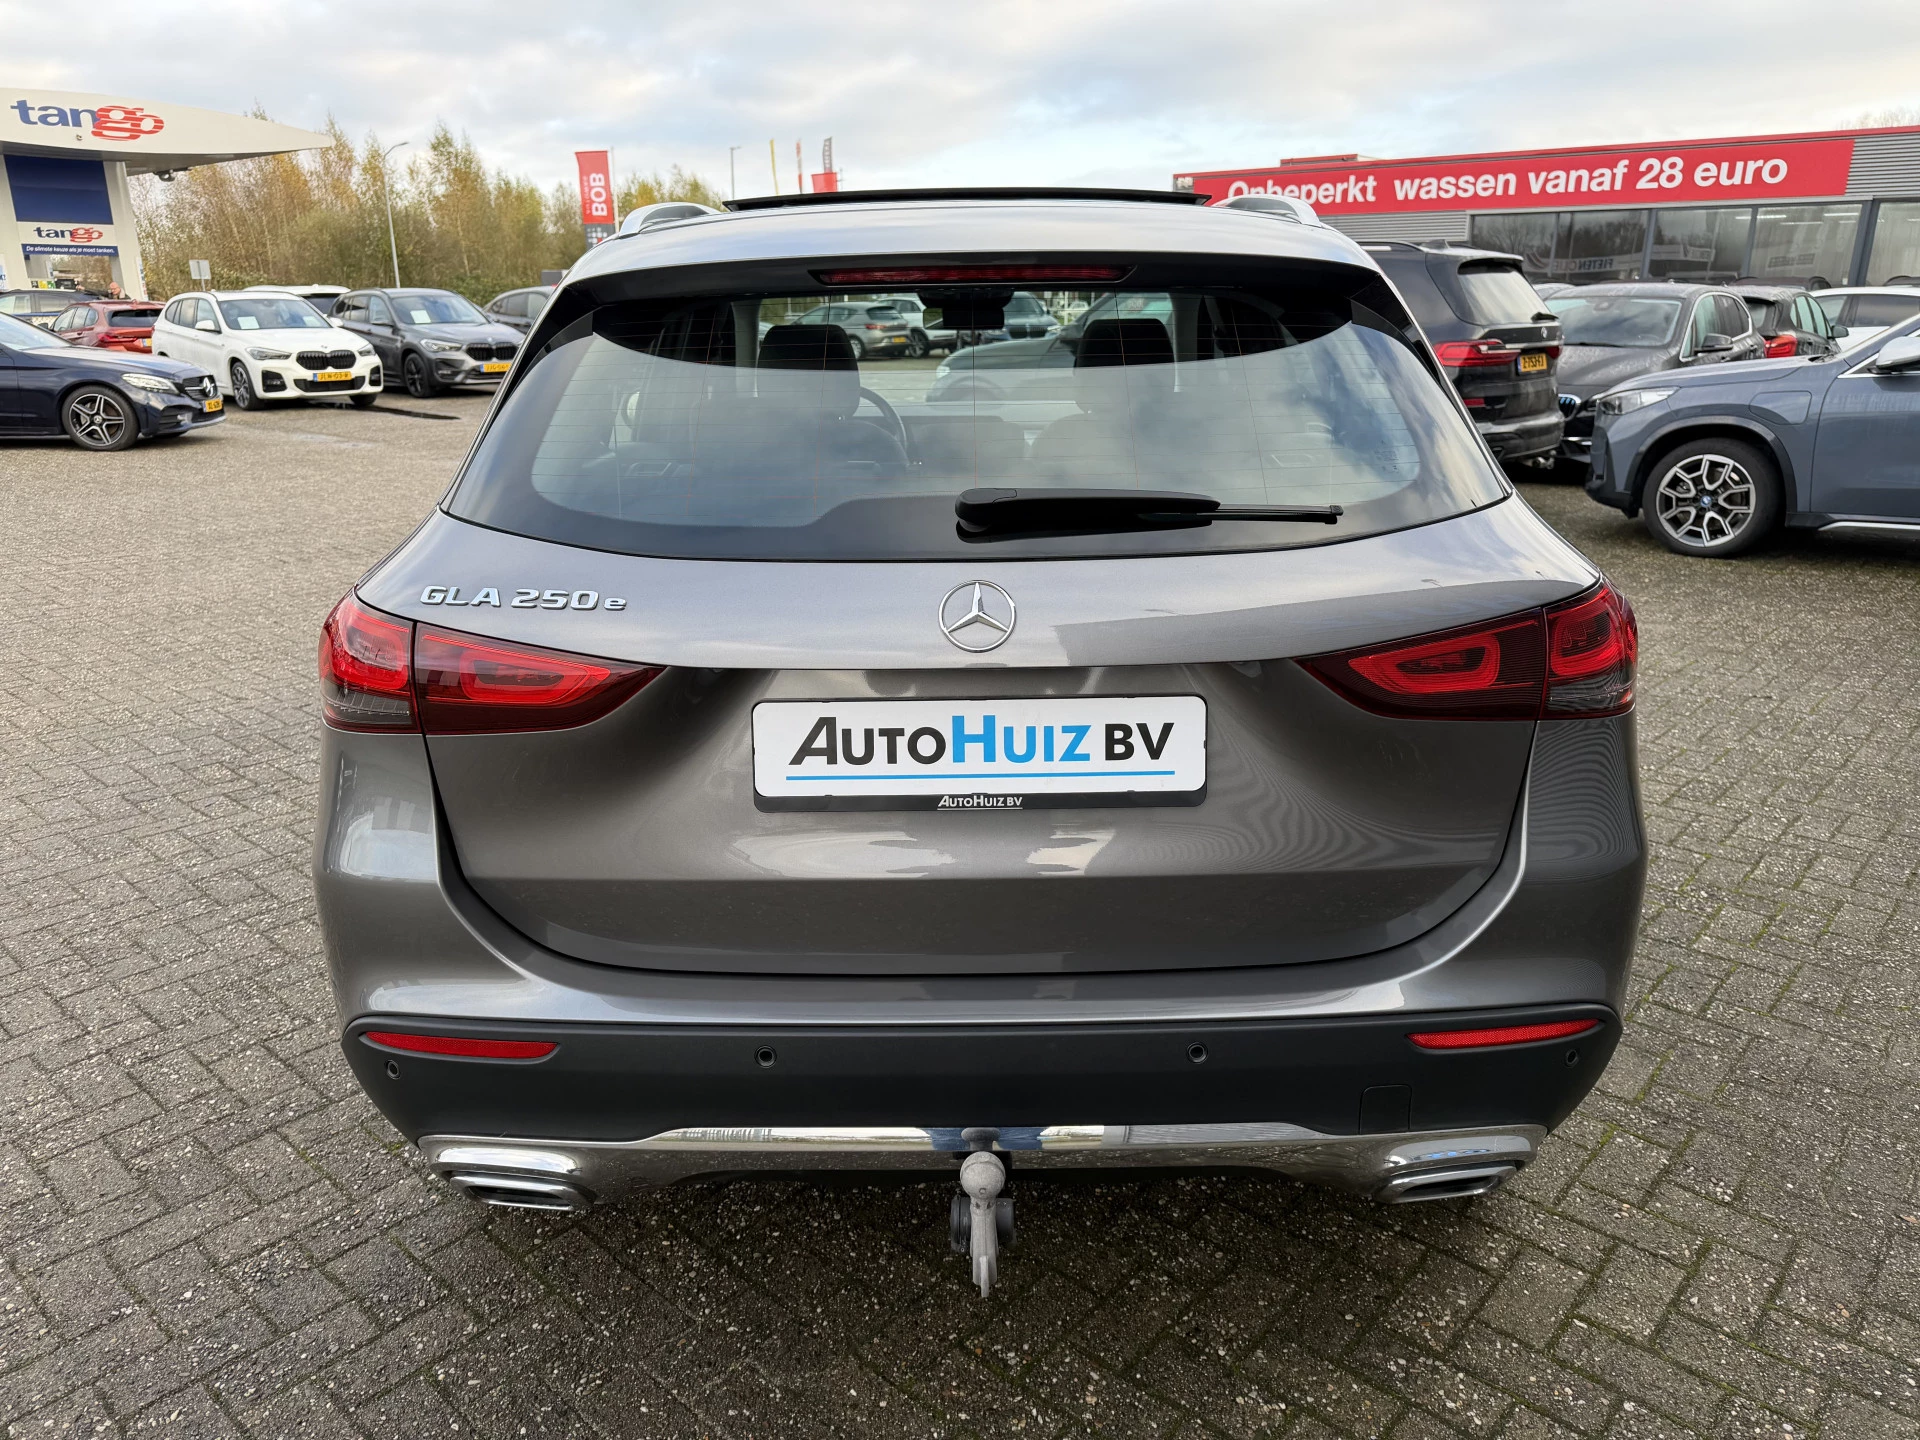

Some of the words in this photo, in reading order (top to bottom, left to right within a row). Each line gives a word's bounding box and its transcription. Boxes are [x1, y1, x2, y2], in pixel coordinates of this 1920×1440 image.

[10, 99, 165, 141] tango
[589, 172, 608, 217] BOB
[1393, 172, 1517, 201] wassen
[1528, 159, 1630, 194] vanaf
[1636, 156, 1684, 190] 28
[1693, 158, 1789, 188] euro
[33, 226, 104, 244] tango
[420, 585, 502, 608] GLA
[1104, 722, 1175, 762] BV
[1006, 796, 1023, 807] BV
